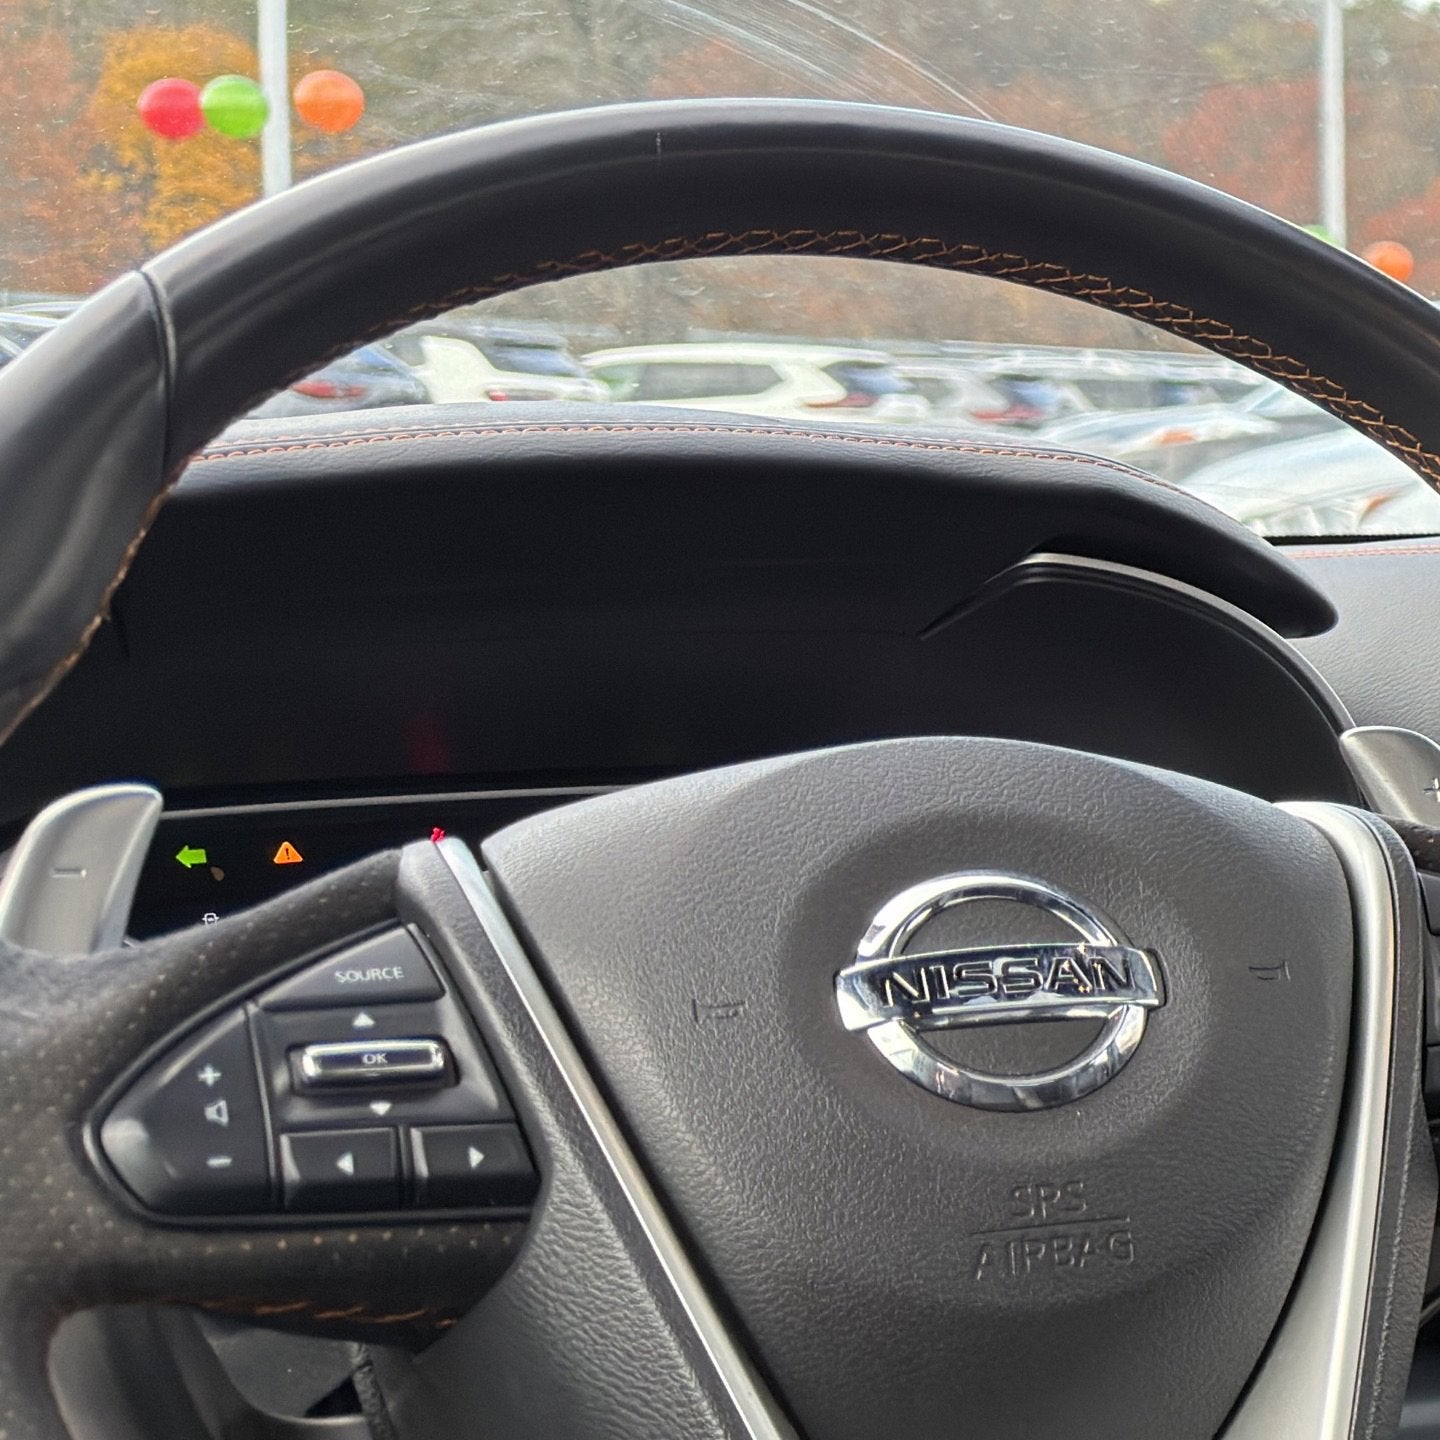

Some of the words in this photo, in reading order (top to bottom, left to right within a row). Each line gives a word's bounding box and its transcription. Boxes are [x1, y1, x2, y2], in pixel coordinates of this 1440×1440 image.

[335, 966, 404, 983] SOURCE
[877, 956, 1137, 1008] NISSAN
[362, 1053, 387, 1064] OK
